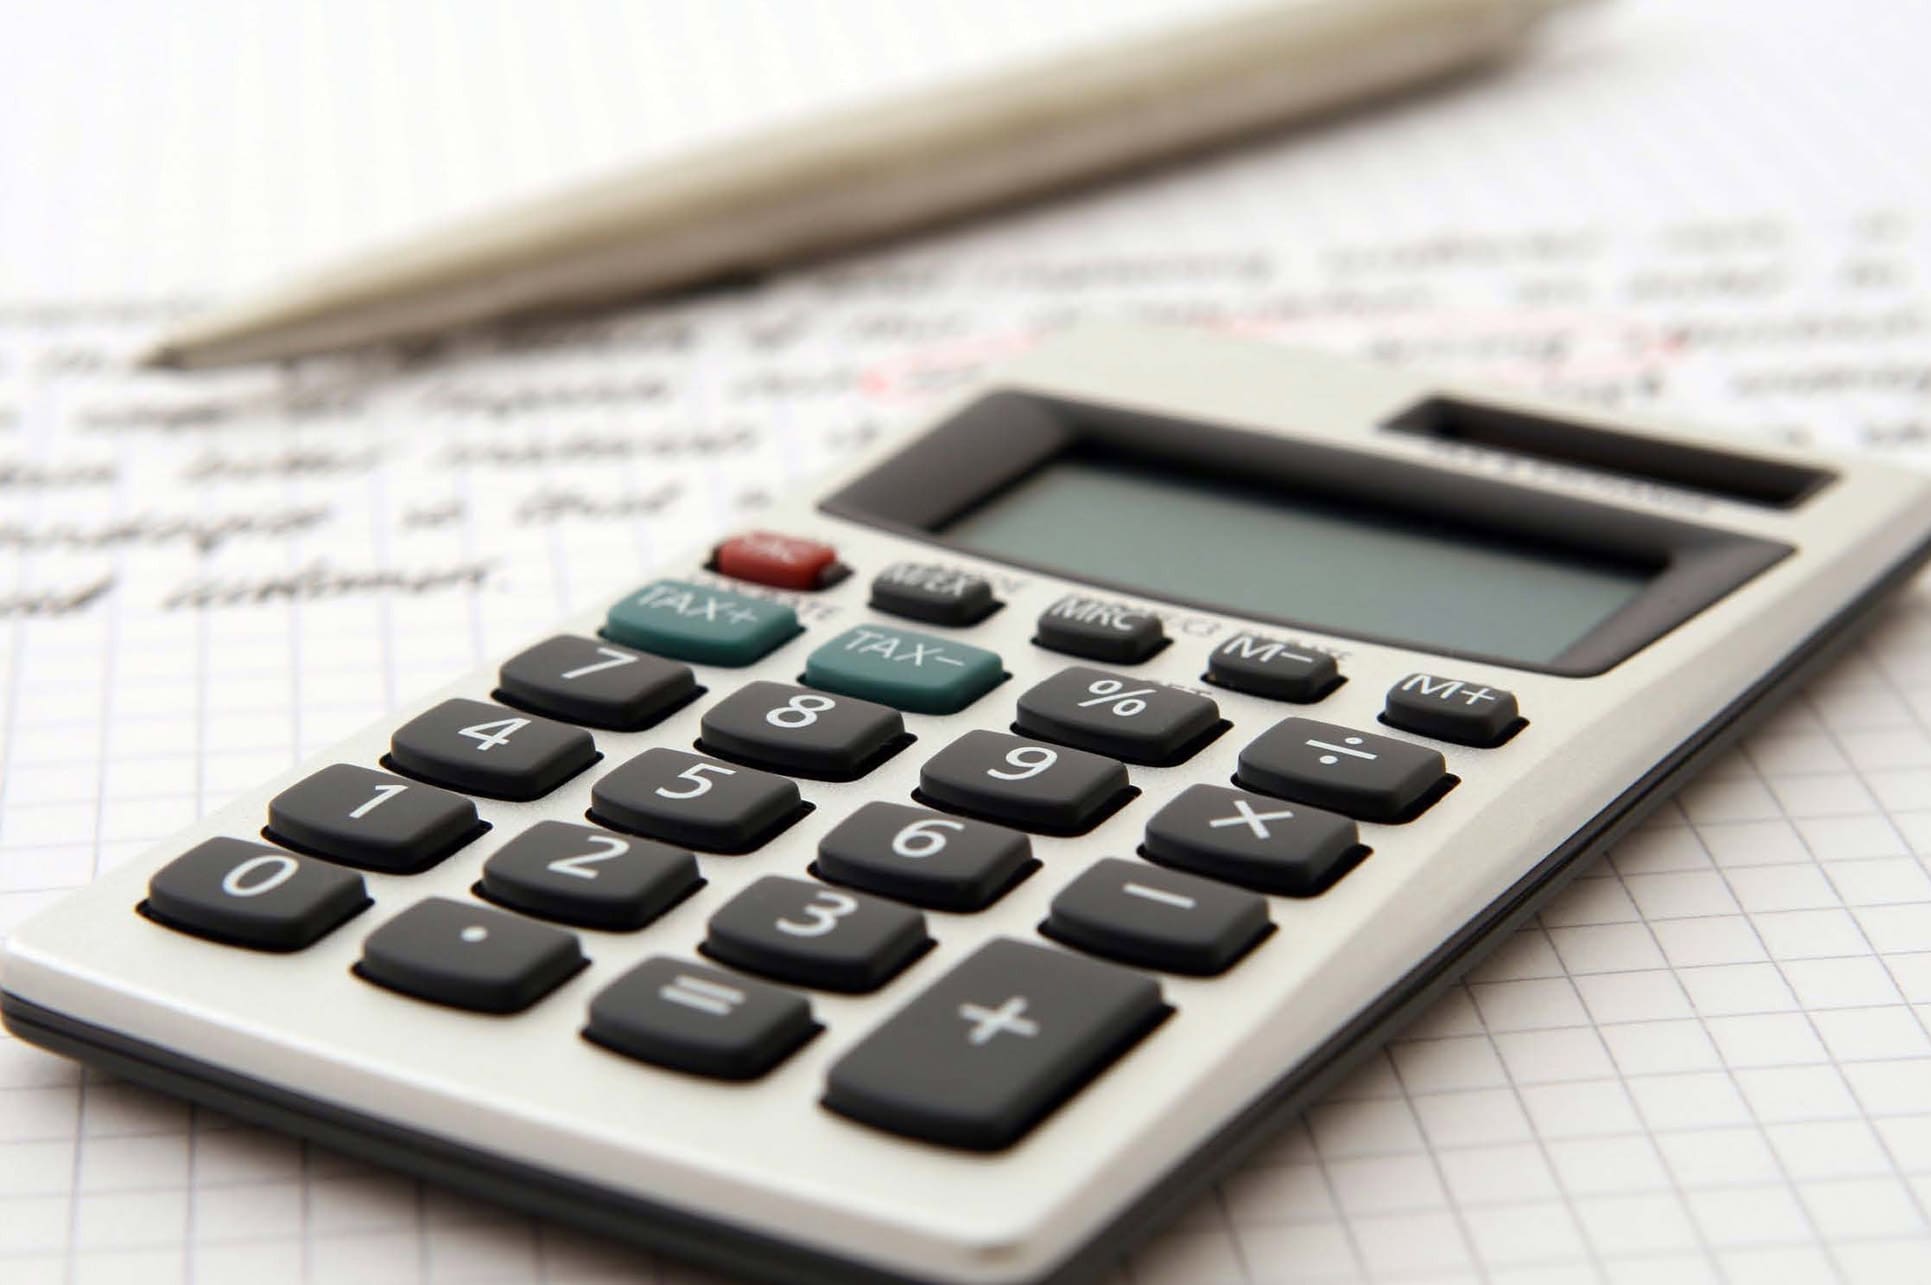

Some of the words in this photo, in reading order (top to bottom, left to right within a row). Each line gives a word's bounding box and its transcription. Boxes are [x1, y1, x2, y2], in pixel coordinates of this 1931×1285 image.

[637, 586, 759, 624] TAX+
[1051, 599, 1142, 631] MRC
[561, 647, 638, 679] 7
[844, 629, 967, 667] TAX-
[1223, 635, 1313, 662] M-
[1077, 679, 1157, 716] %
[1401, 674, 1495, 705] M+
[765, 694, 836, 728] 8
[457, 717, 532, 751] 4
[654, 762, 737, 799] 5
[986, 746, 1059, 781] 9
[349, 783, 409, 819] 1
[891, 818, 966, 858] 6
[547, 834, 630, 879] 2
[221, 854, 299, 897] 0
[775, 890, 859, 937] 3
